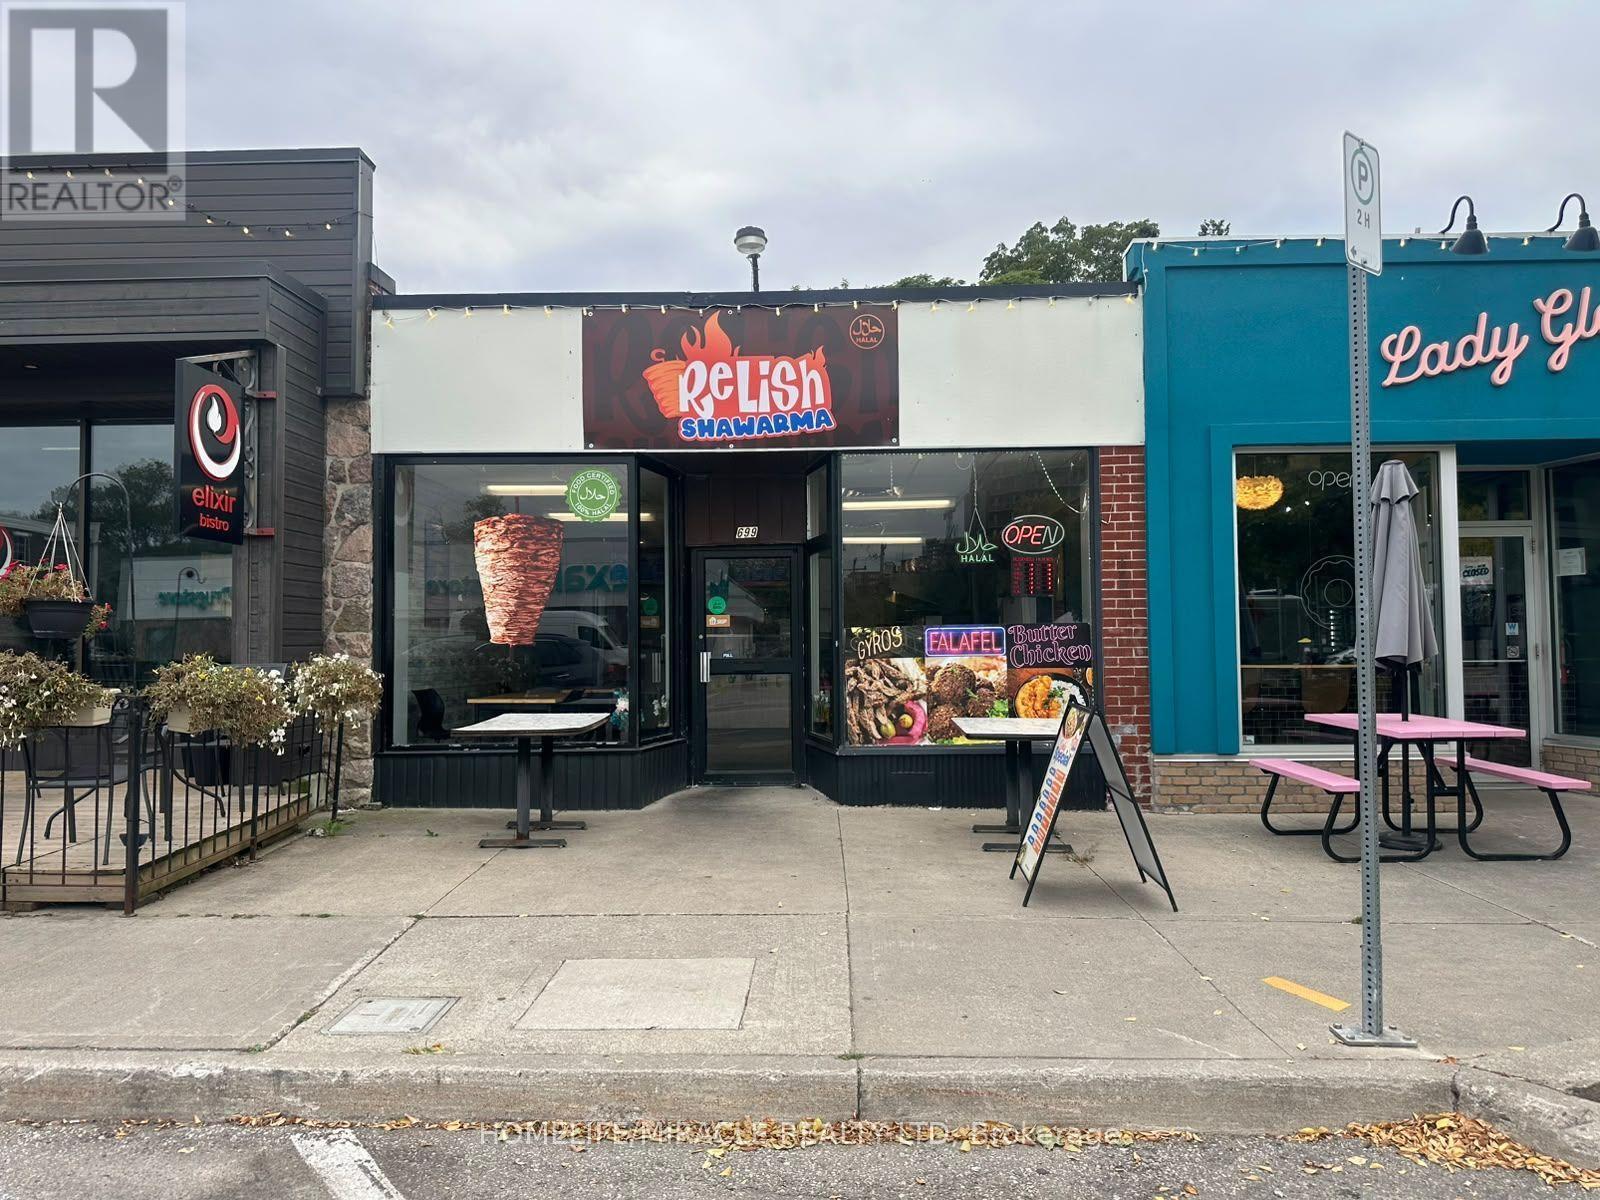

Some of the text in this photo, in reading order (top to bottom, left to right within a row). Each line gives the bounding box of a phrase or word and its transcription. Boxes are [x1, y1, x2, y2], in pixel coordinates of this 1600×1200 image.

[1356, 208, 1371, 229] 2 H
[855, 336, 878, 344] HALAL
[1381, 312, 1529, 387] Lady
[681, 408, 833, 438] SHAWARMA
[192, 485, 237, 513] elixir
[592, 503, 612, 516] HALAL
[199, 512, 230, 531] bistro
[736, 527, 758, 538] 699
[1004, 525, 1060, 545] OPEN
[960, 554, 994, 563] HALAL
[1462, 567, 1490, 578] CLOSED
[857, 626, 903, 660] GYROS
[929, 630, 1001, 652] FALAFEL
[1007, 624, 1078, 645] Butter
[1010, 640, 1092, 668] Chicken
